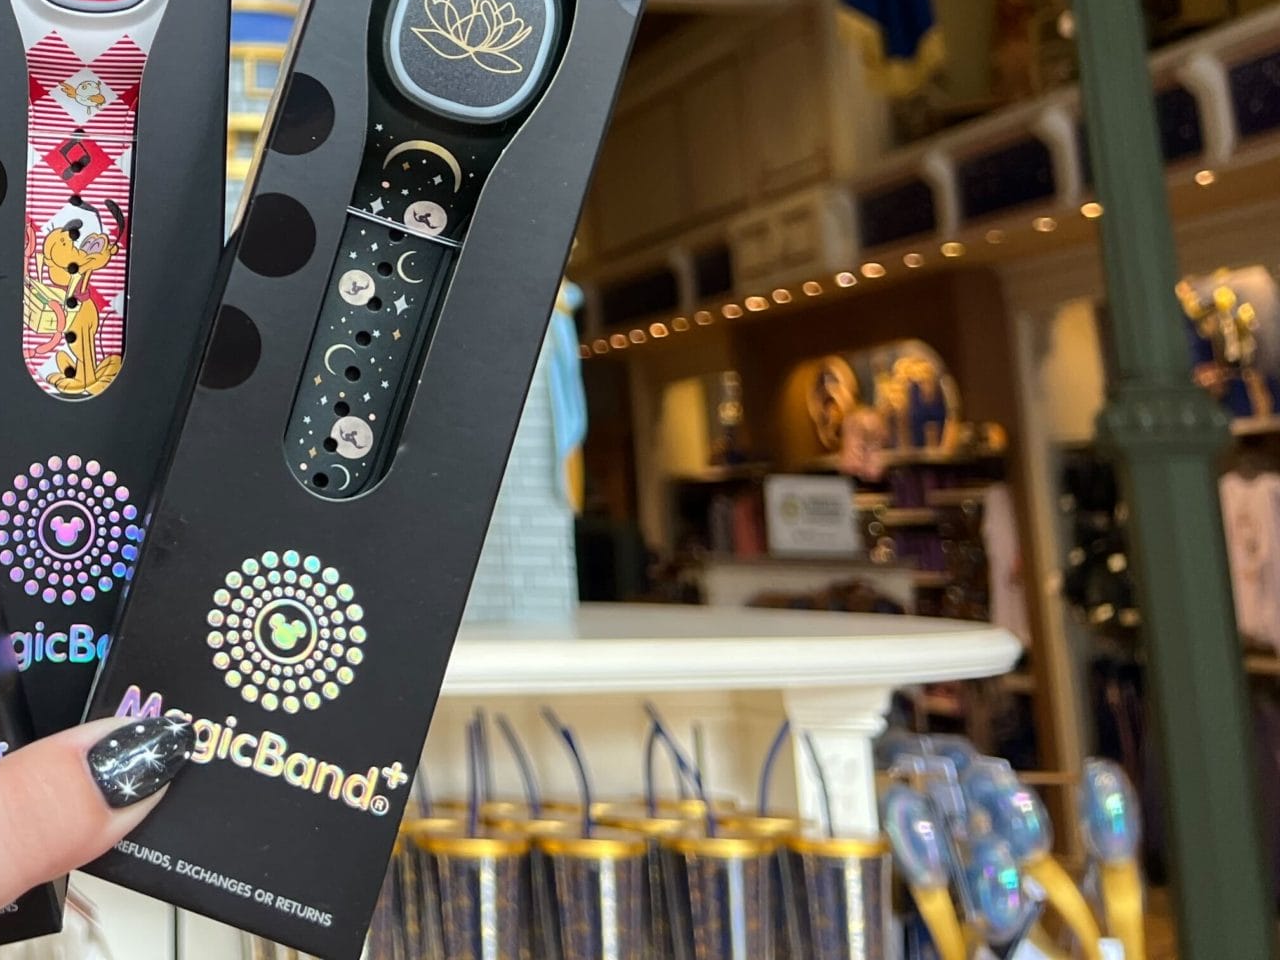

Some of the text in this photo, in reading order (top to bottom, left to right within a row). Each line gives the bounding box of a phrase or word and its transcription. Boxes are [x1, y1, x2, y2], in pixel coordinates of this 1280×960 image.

[114, 839, 334, 927] REFUNDS, EXCHANGES OR RETURNS
